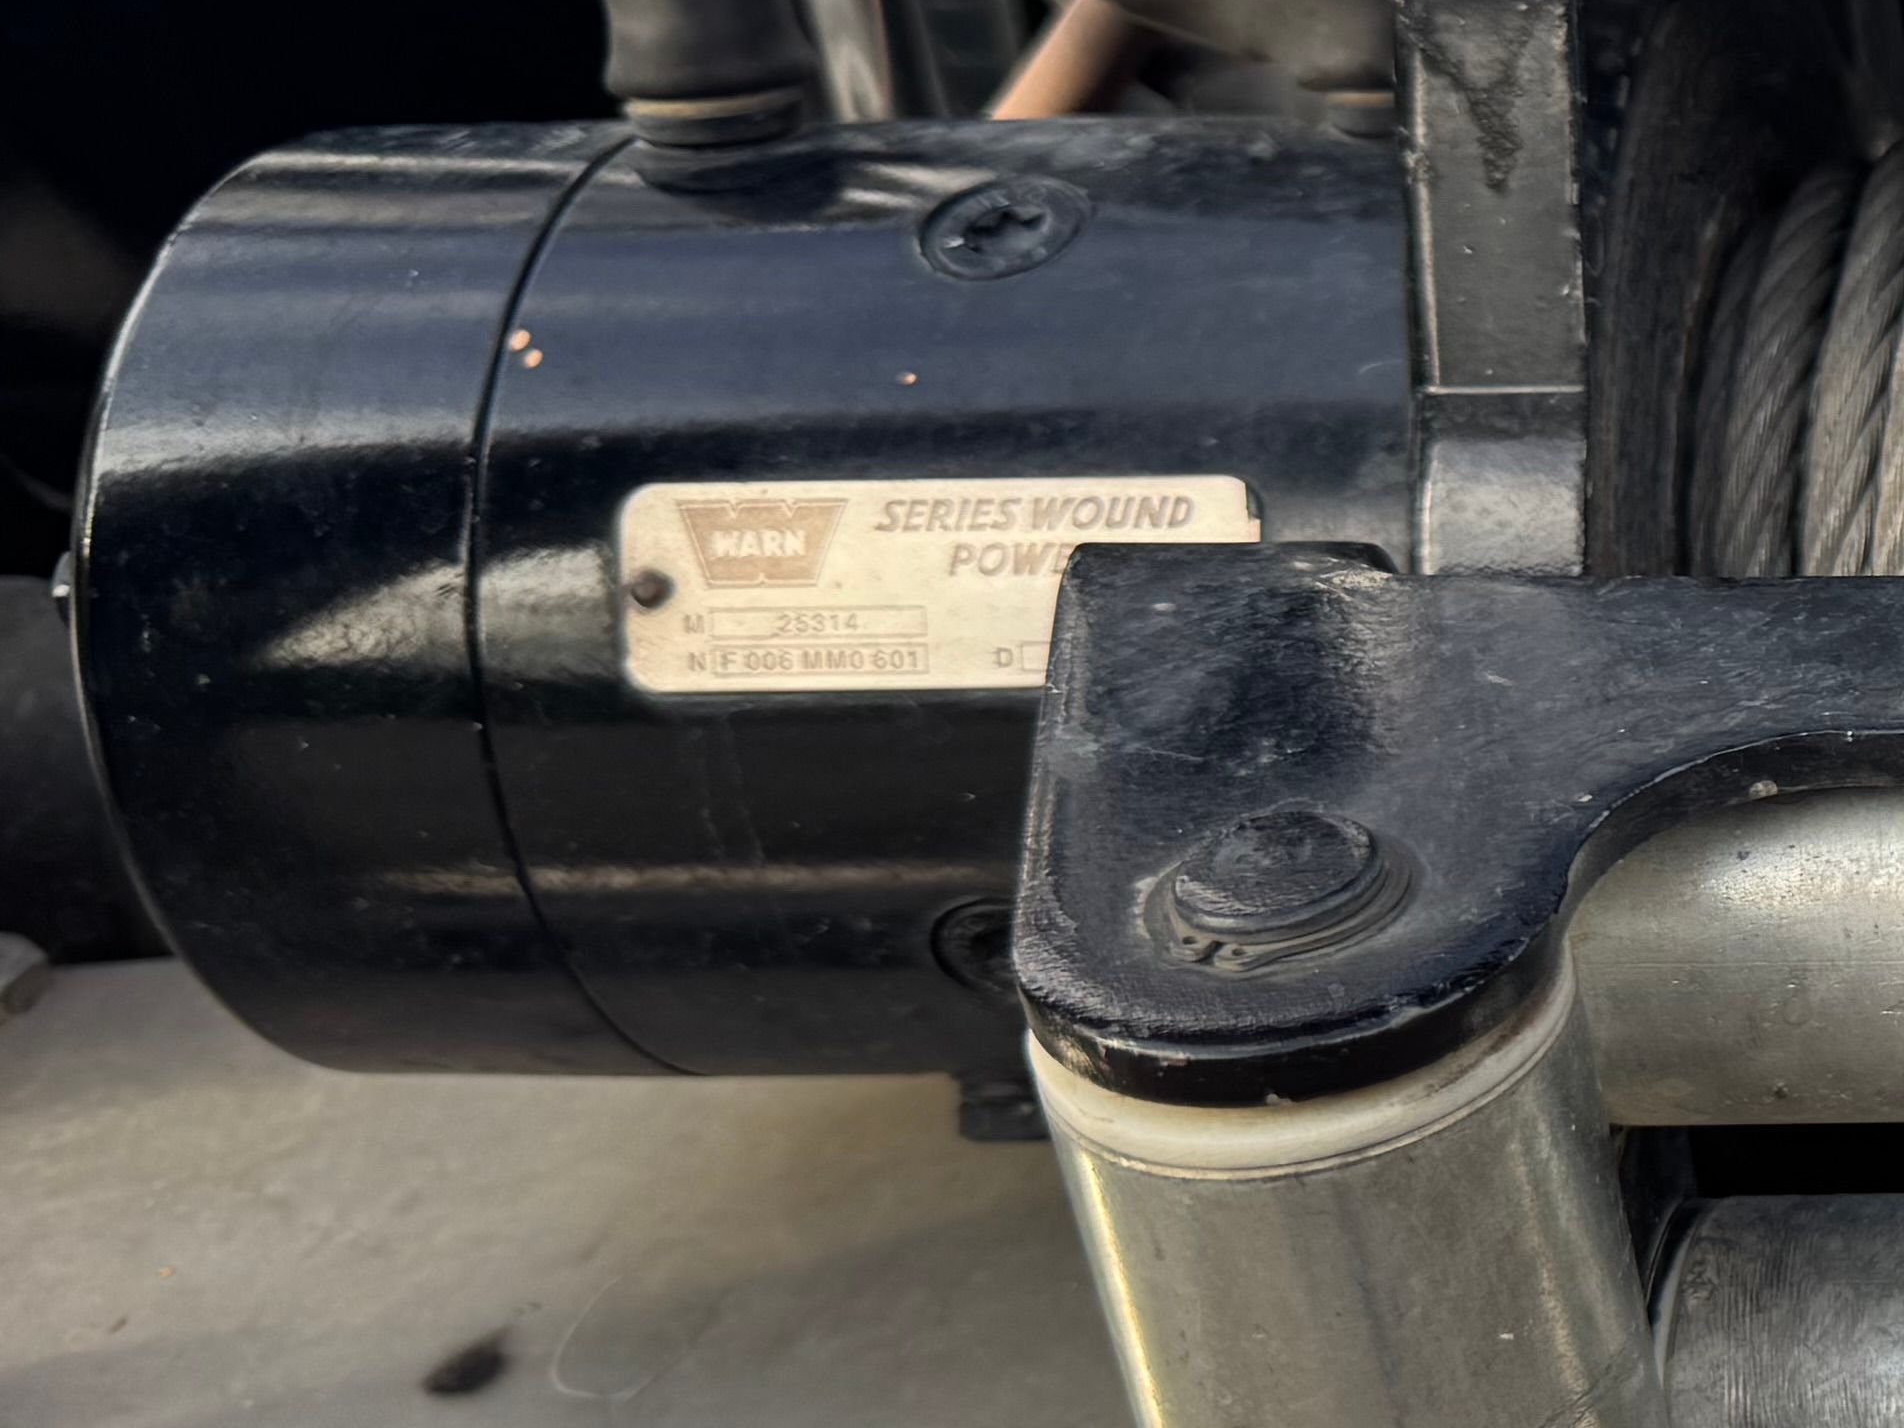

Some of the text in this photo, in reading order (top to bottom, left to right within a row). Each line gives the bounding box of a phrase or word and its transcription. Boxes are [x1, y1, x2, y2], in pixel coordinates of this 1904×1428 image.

[875, 495, 1195, 532] SERIES WOUND
[710, 528, 807, 557] WARN
[950, 543, 1078, 576] POWE
